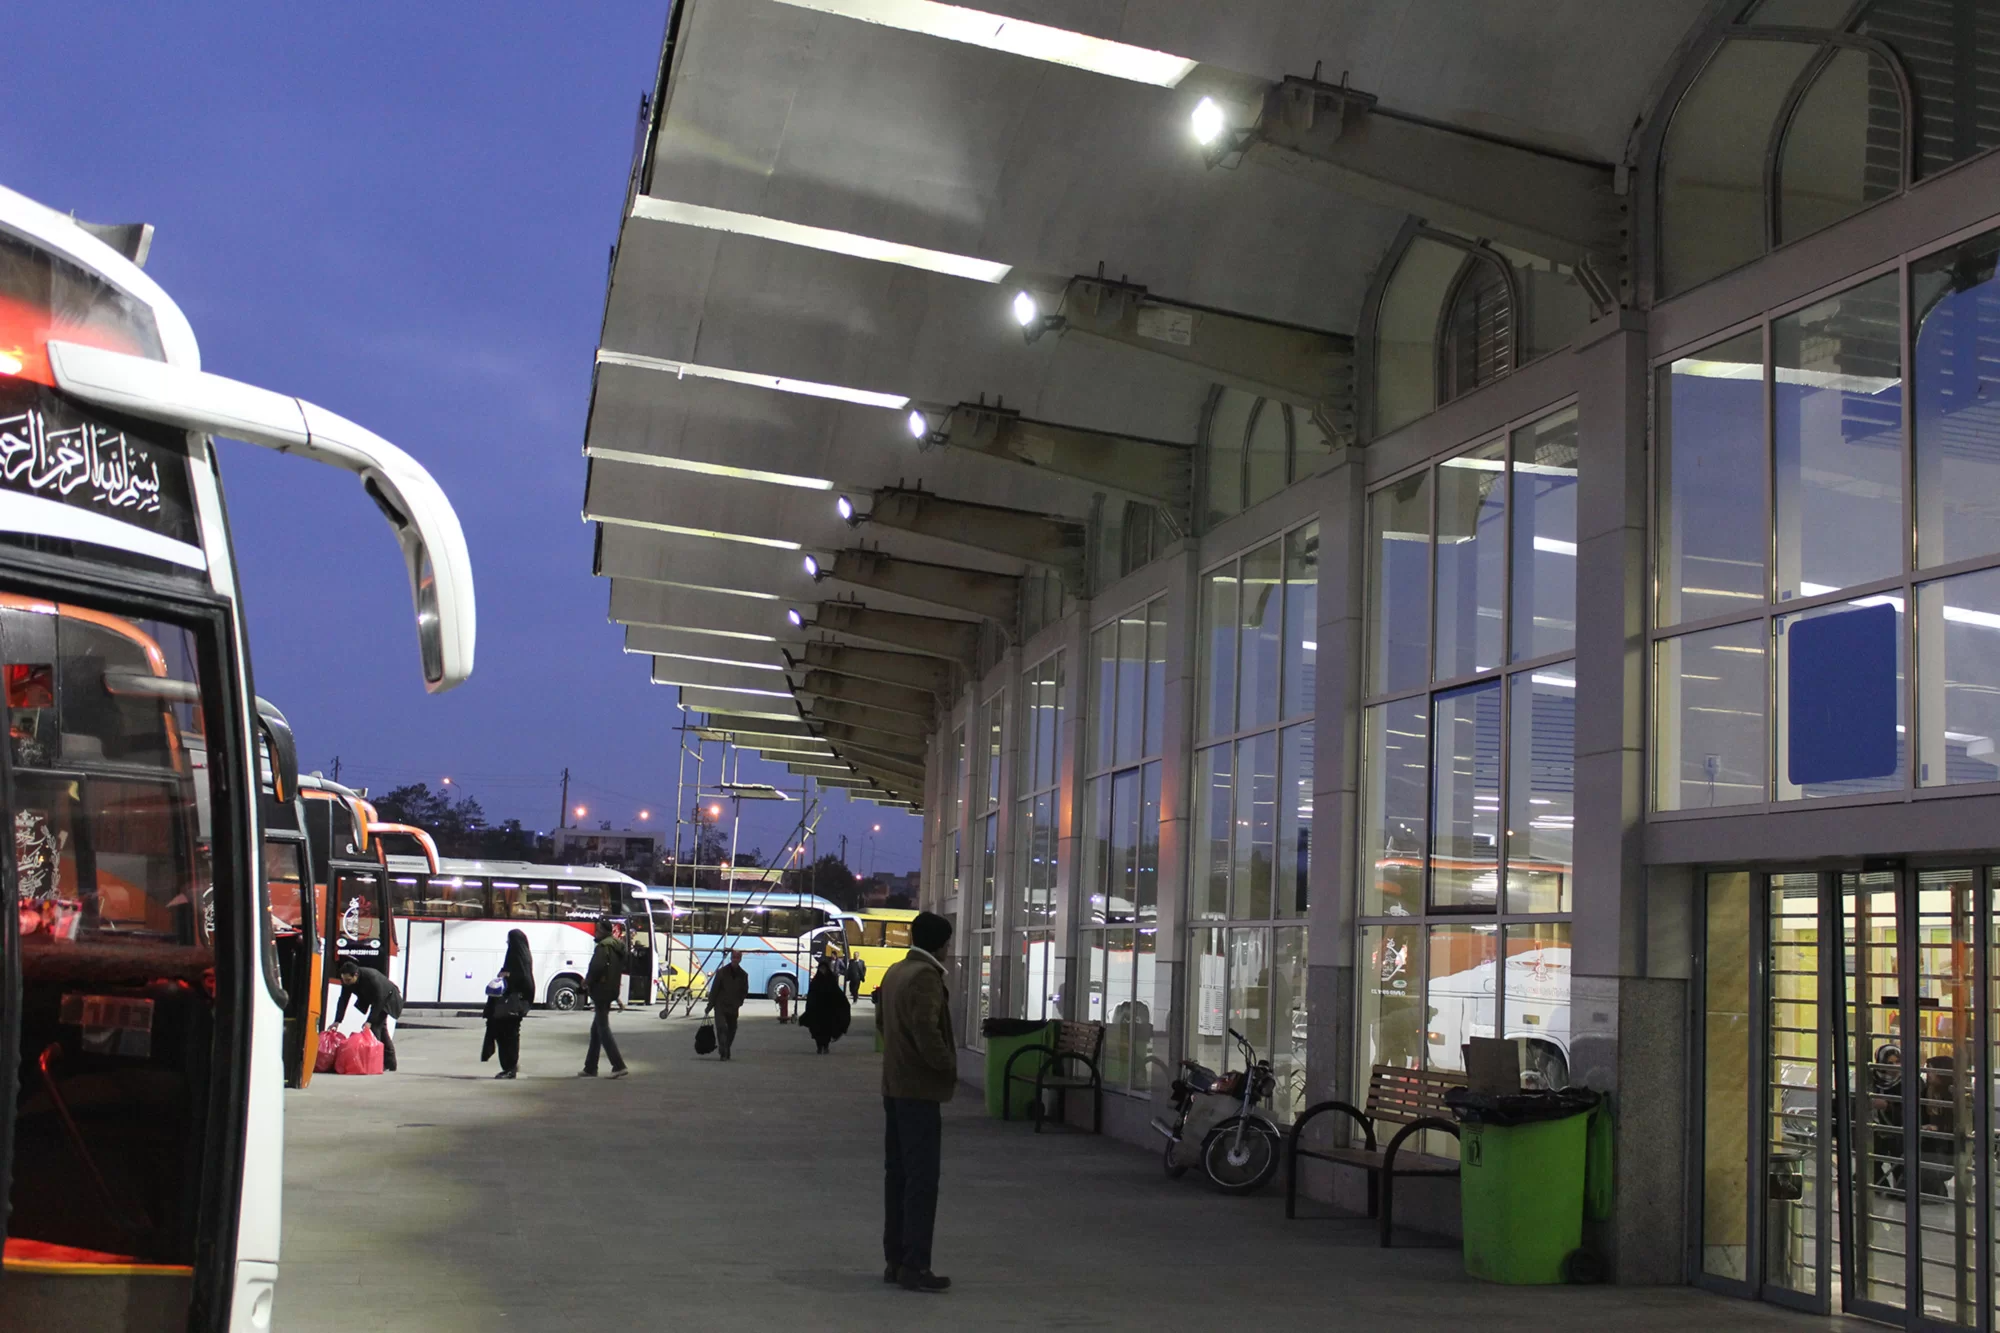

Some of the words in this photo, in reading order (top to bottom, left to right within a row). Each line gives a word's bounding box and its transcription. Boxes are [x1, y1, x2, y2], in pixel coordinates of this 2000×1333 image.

[28, 422, 99, 496] الرحمن
[91, 431, 128, 501] الله
[108, 449, 160, 512] بسم
